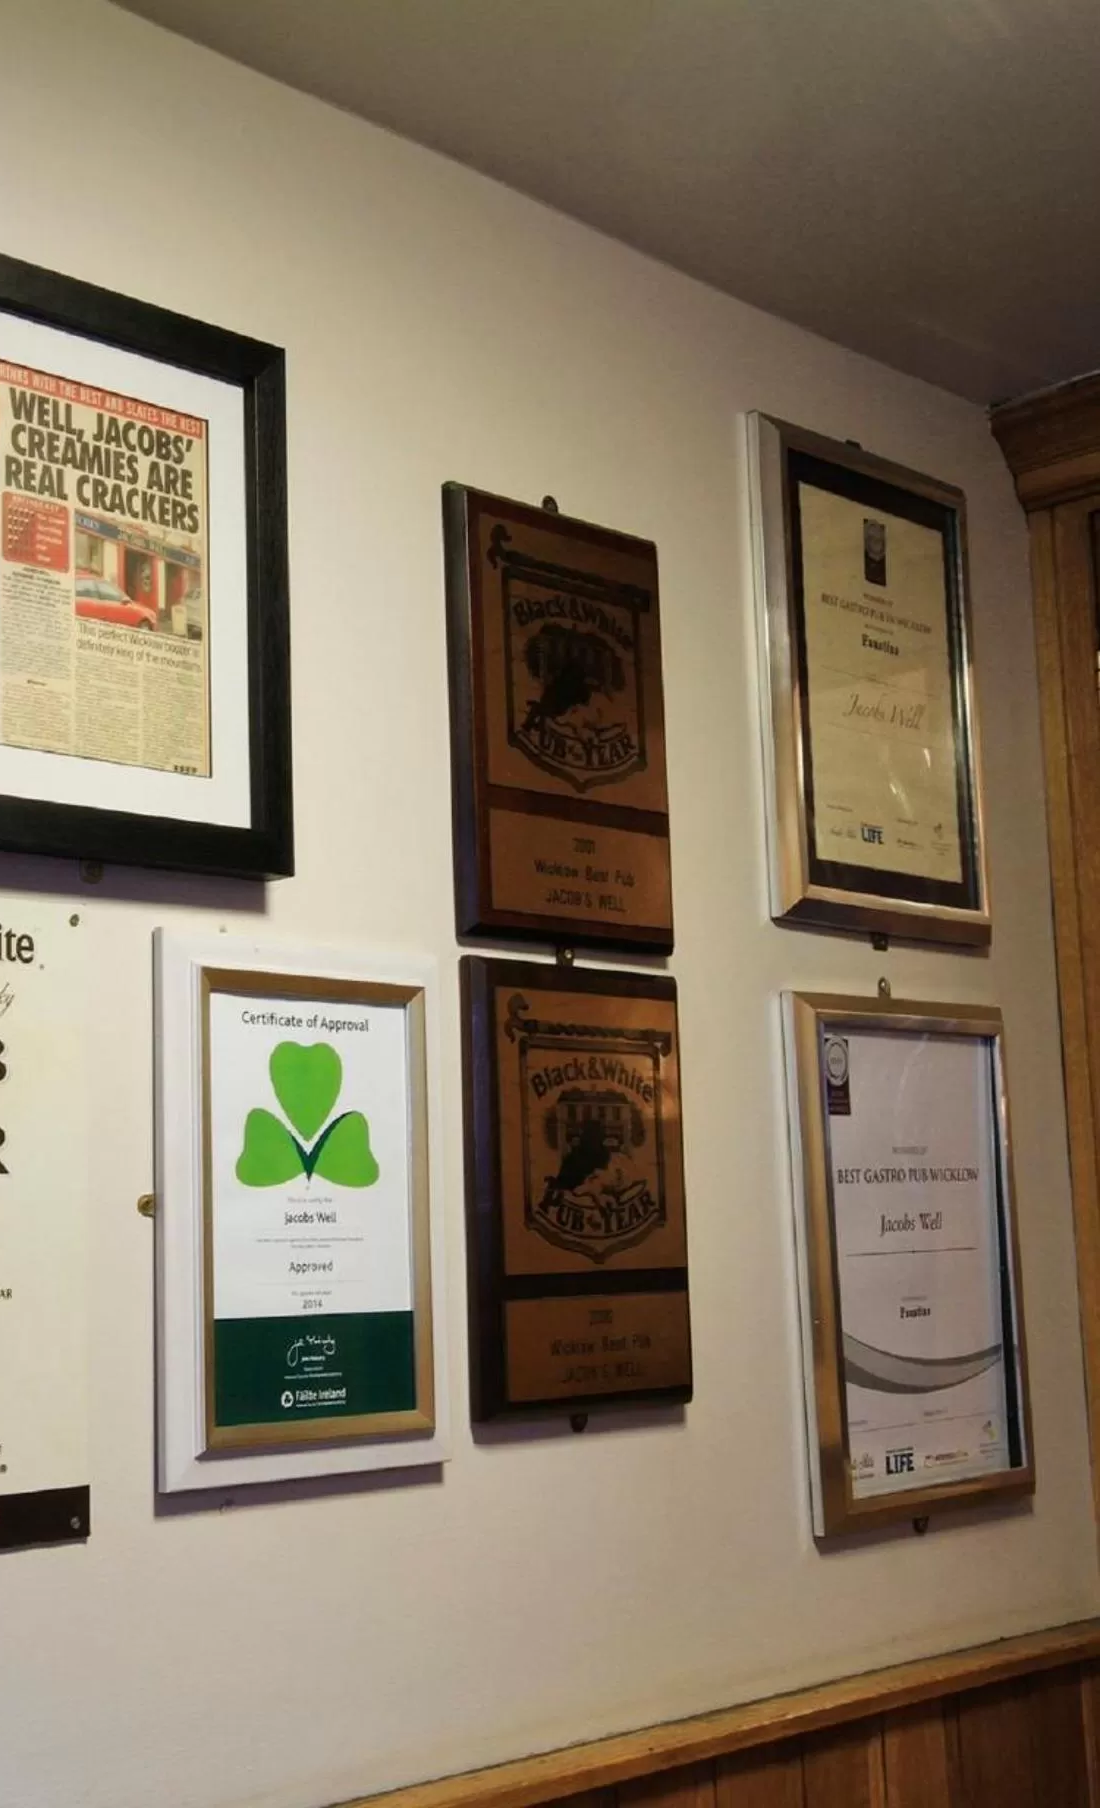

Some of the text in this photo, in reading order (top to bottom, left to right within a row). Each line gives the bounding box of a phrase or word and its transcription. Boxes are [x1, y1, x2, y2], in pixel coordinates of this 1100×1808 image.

[9, 387, 193, 465] WELL, JACOBS'
[11, 423, 193, 501] CREAMIES ARE
[5, 455, 68, 501] REAL
[76, 475, 199, 534] CRACKERS
[241, 1011, 369, 1033] Certificate of Approval
[837, 1169, 860, 1184] BEST
[864, 1168, 906, 1183] GASTRO
[316, 1212, 337, 1224] Well
[880, 1212, 942, 1236] Jacobs Well
[288, 1261, 334, 1275] Approved
[886, 1453, 914, 1475] LIFE
